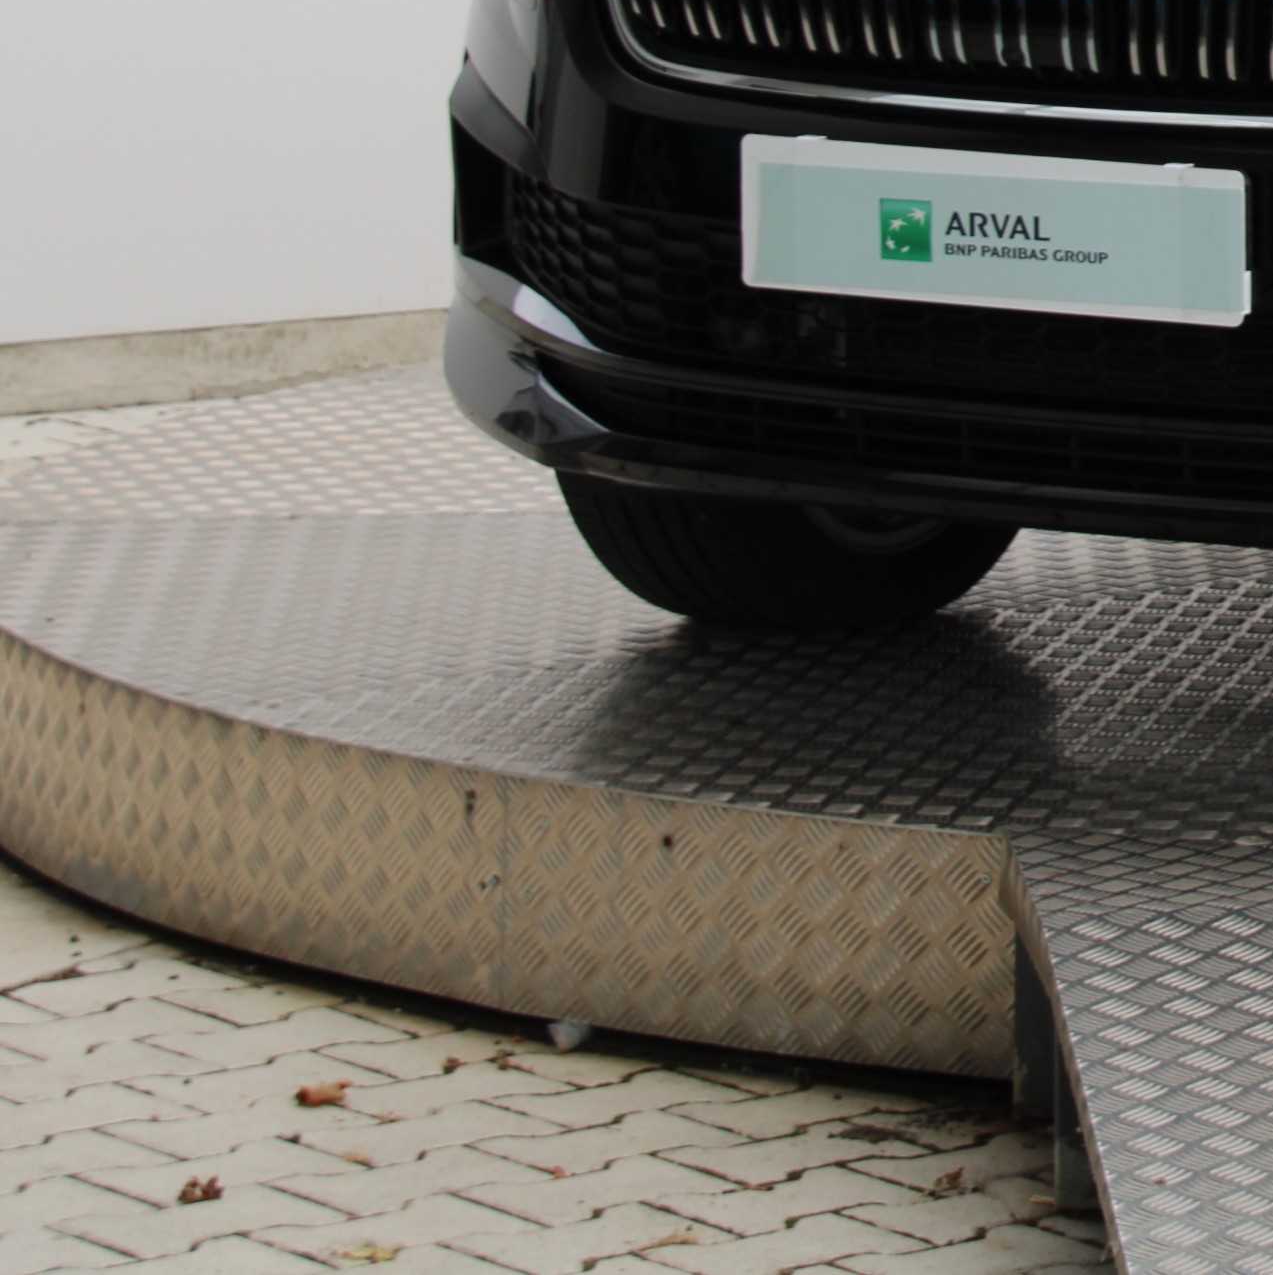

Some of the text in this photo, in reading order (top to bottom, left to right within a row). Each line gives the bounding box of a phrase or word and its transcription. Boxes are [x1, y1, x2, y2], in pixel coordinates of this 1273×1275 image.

[945, 211, 1051, 242] ARVAL
[944, 243, 1109, 265] BNP PARIBAS GROUP
